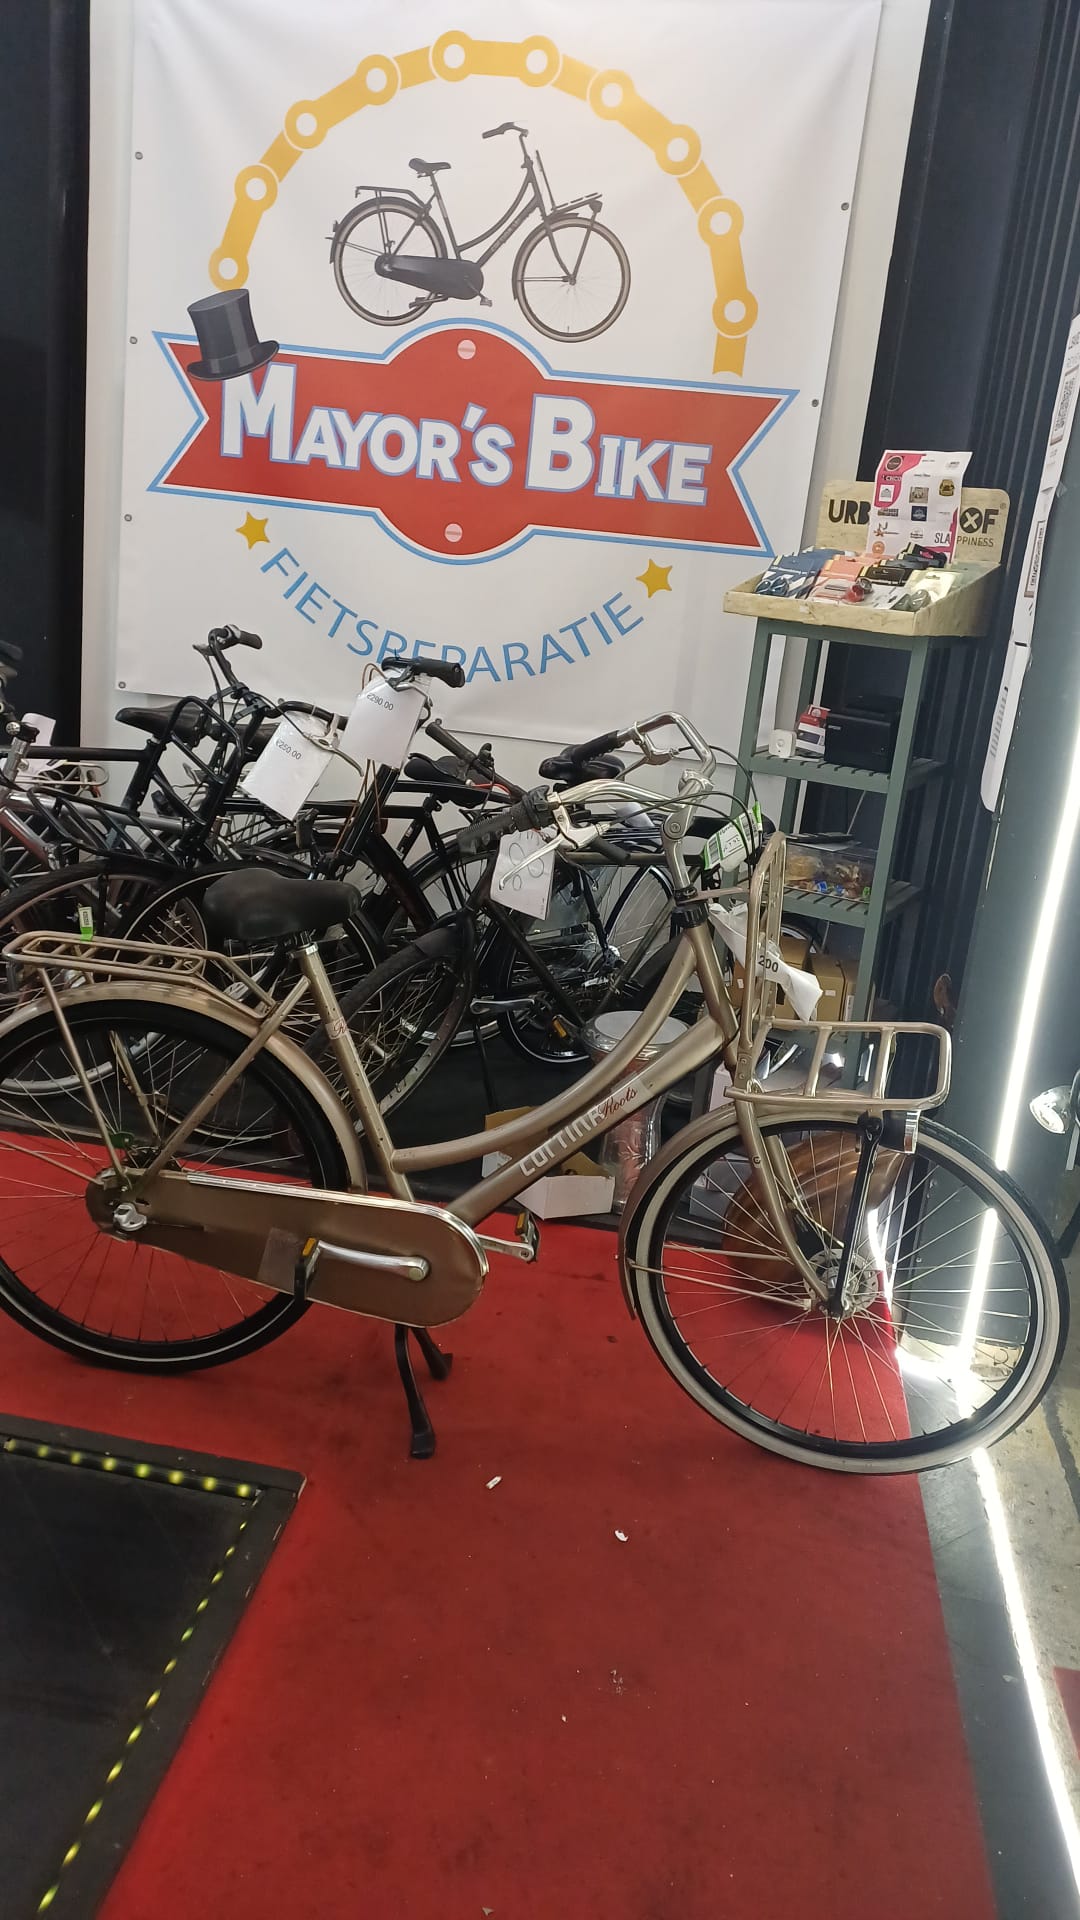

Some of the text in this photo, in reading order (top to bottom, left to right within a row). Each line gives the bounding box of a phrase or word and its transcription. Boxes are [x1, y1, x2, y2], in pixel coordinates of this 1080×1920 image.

[221, 362, 713, 506] MAYOR'S BIKE
[828, 499, 872, 525] URB
[956, 535, 994, 547] PPINESS
